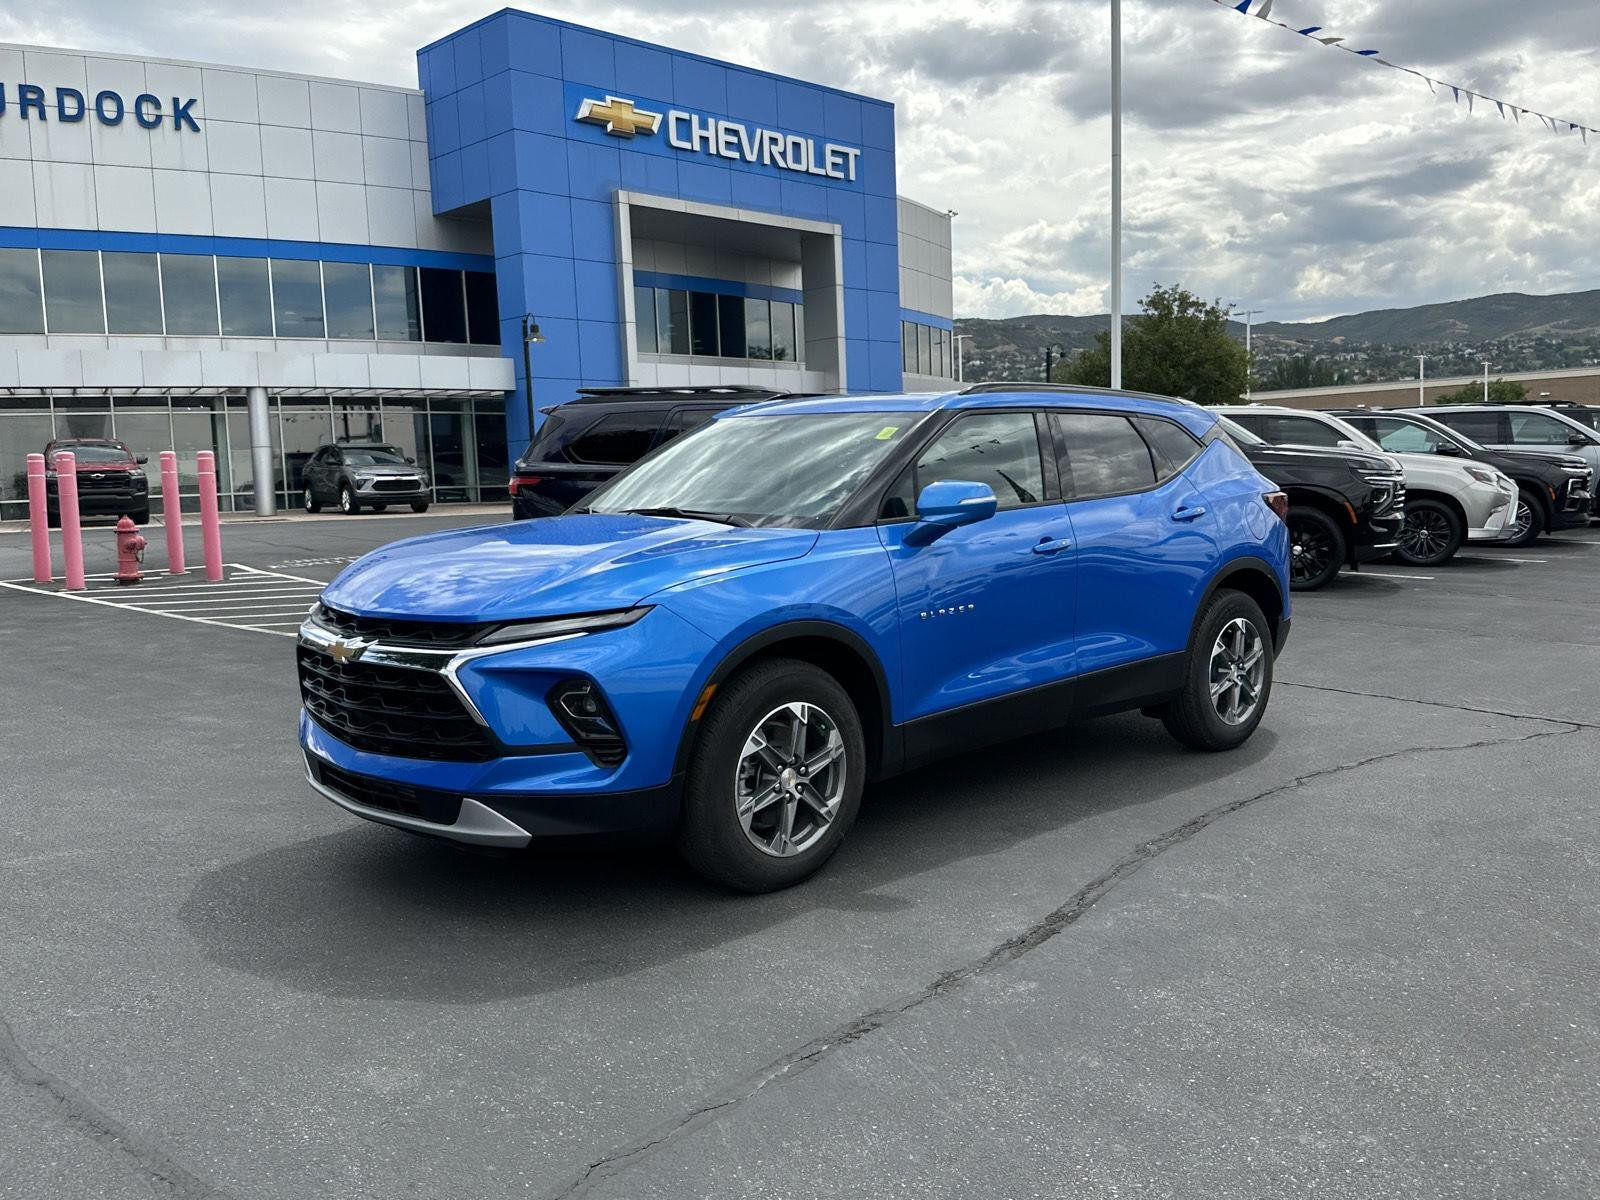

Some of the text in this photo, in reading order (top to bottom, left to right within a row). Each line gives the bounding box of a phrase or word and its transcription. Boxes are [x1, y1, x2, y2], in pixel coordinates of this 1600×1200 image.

[0, 83, 201, 132] RDOCK
[668, 110, 861, 181] CHEVROLET
[920, 604, 975, 620] BLAZER
